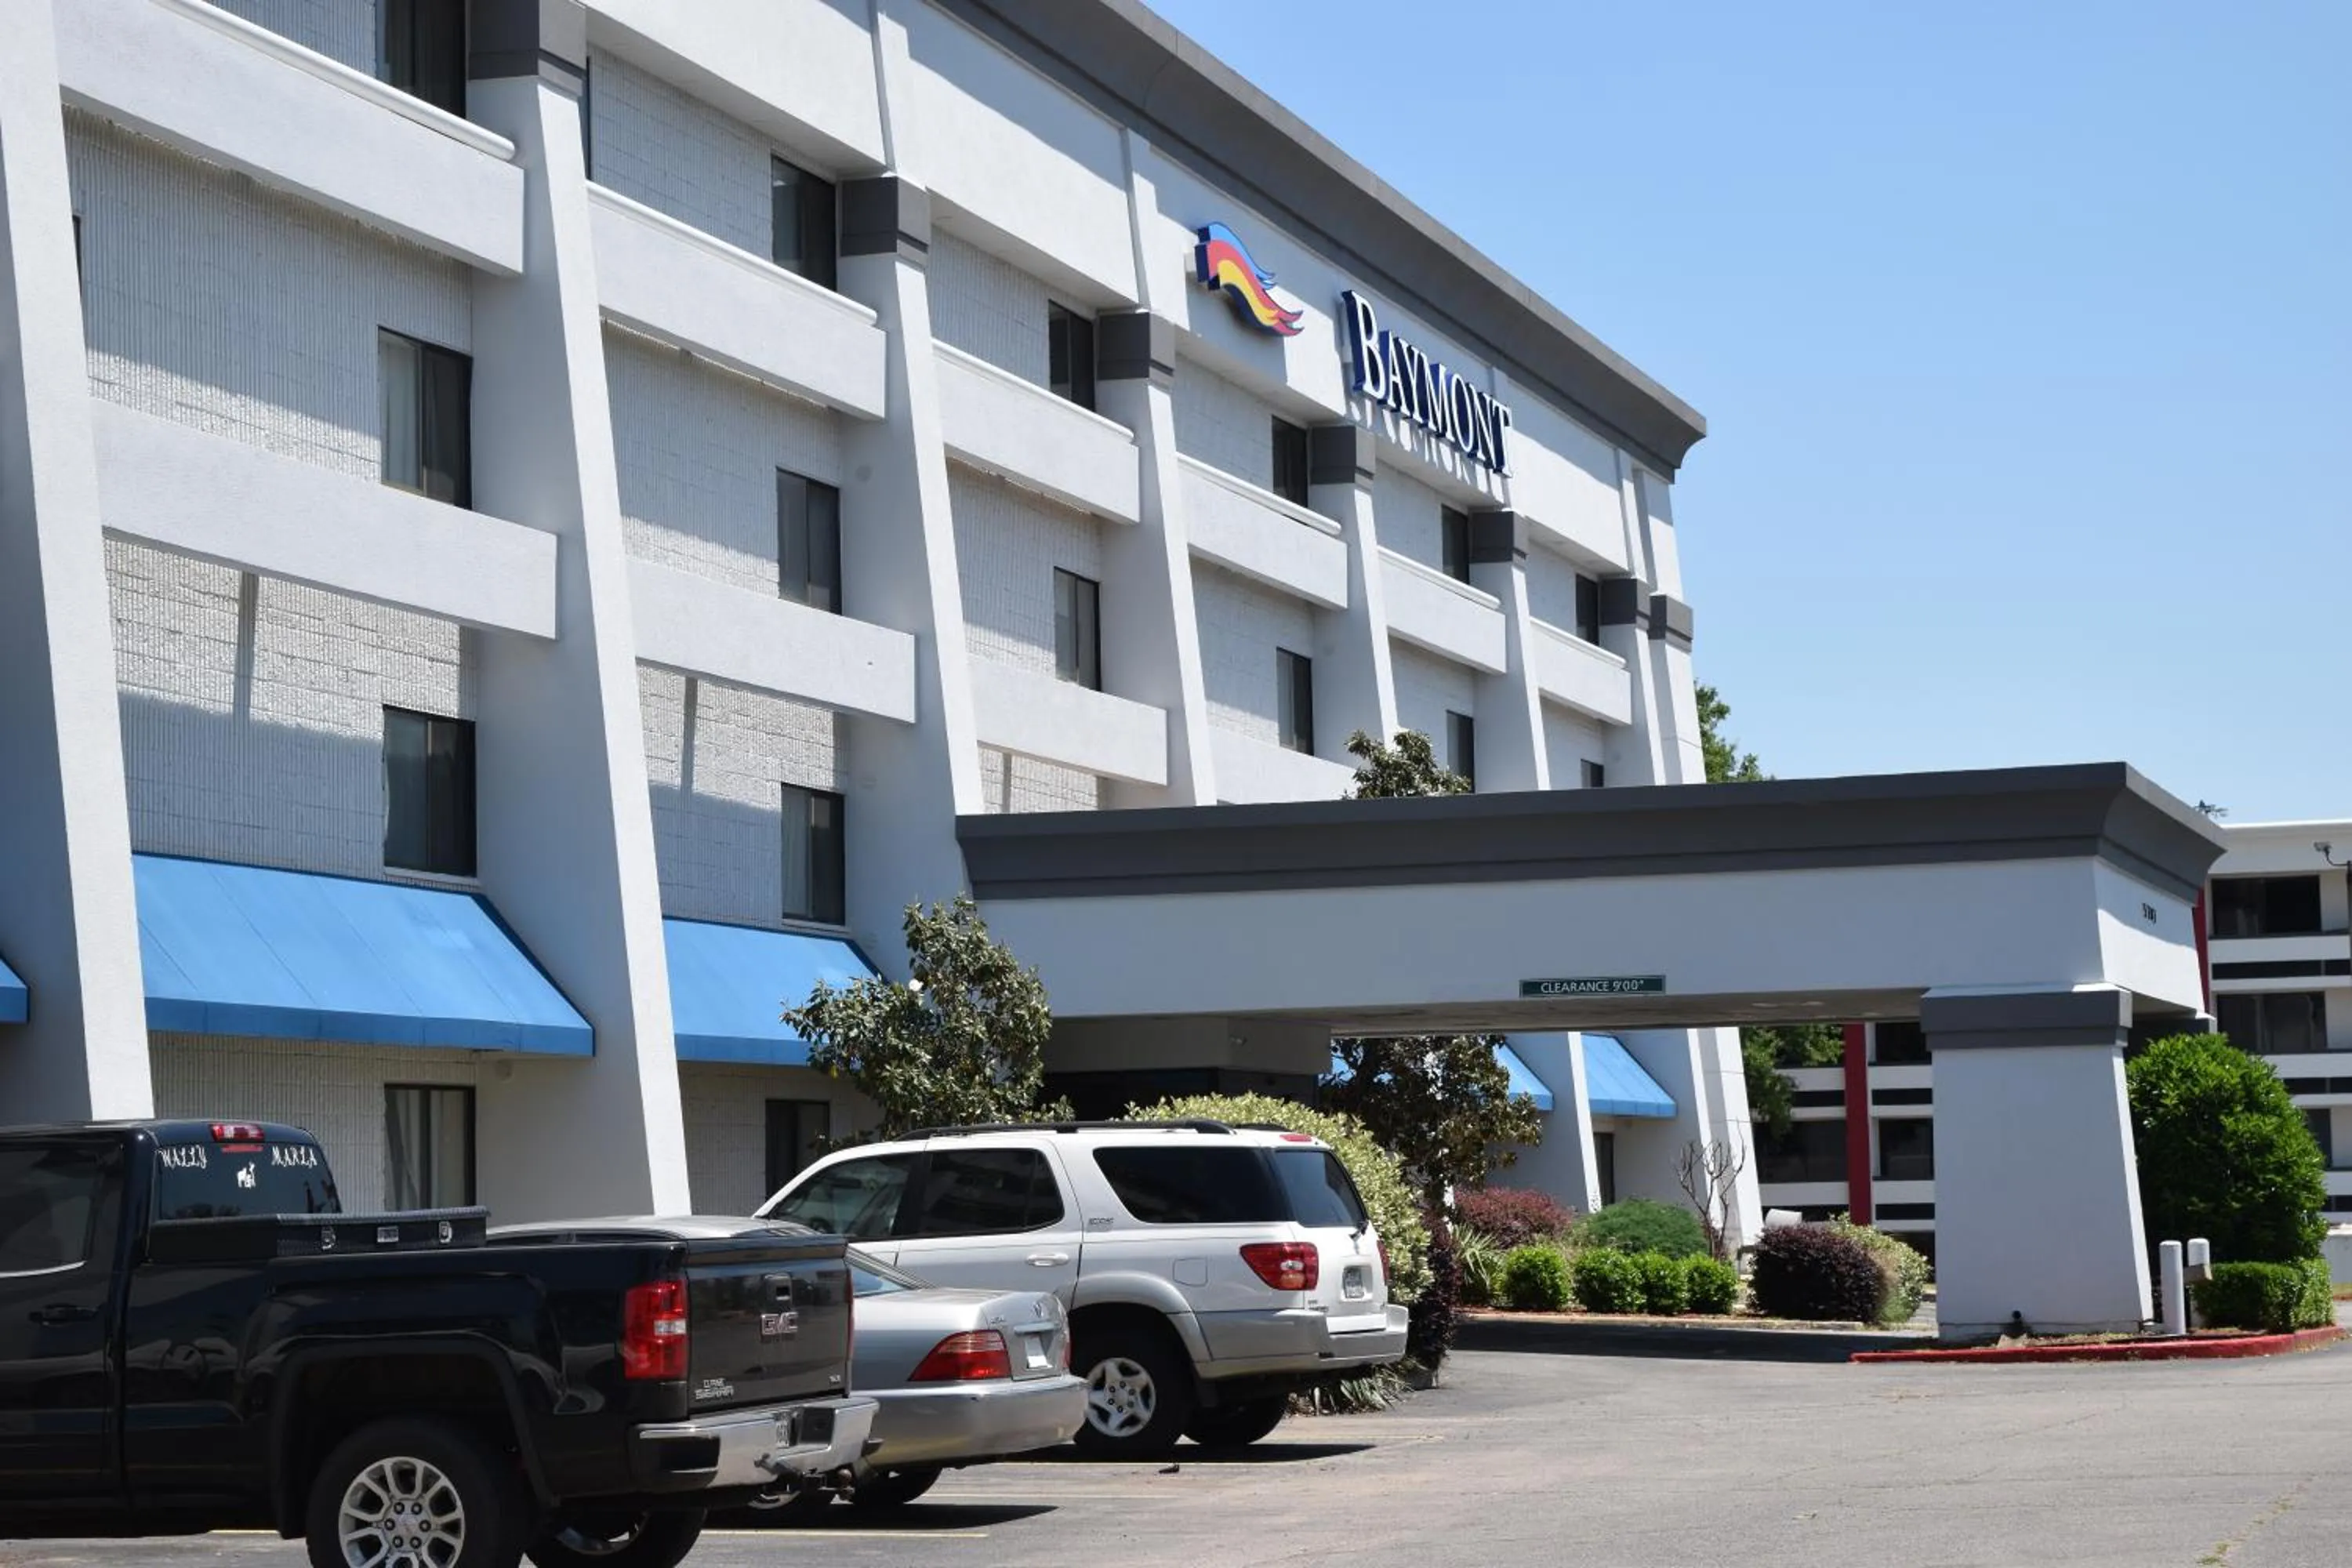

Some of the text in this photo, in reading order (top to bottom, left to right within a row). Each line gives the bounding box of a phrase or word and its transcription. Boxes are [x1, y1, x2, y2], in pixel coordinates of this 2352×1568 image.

[1342, 290, 1512, 477] BAYMONT
[1541, 981, 1609, 993] CLEARANCE
[158, 1145, 208, 1169] WALLY
[762, 1312, 798, 1335] GMC
